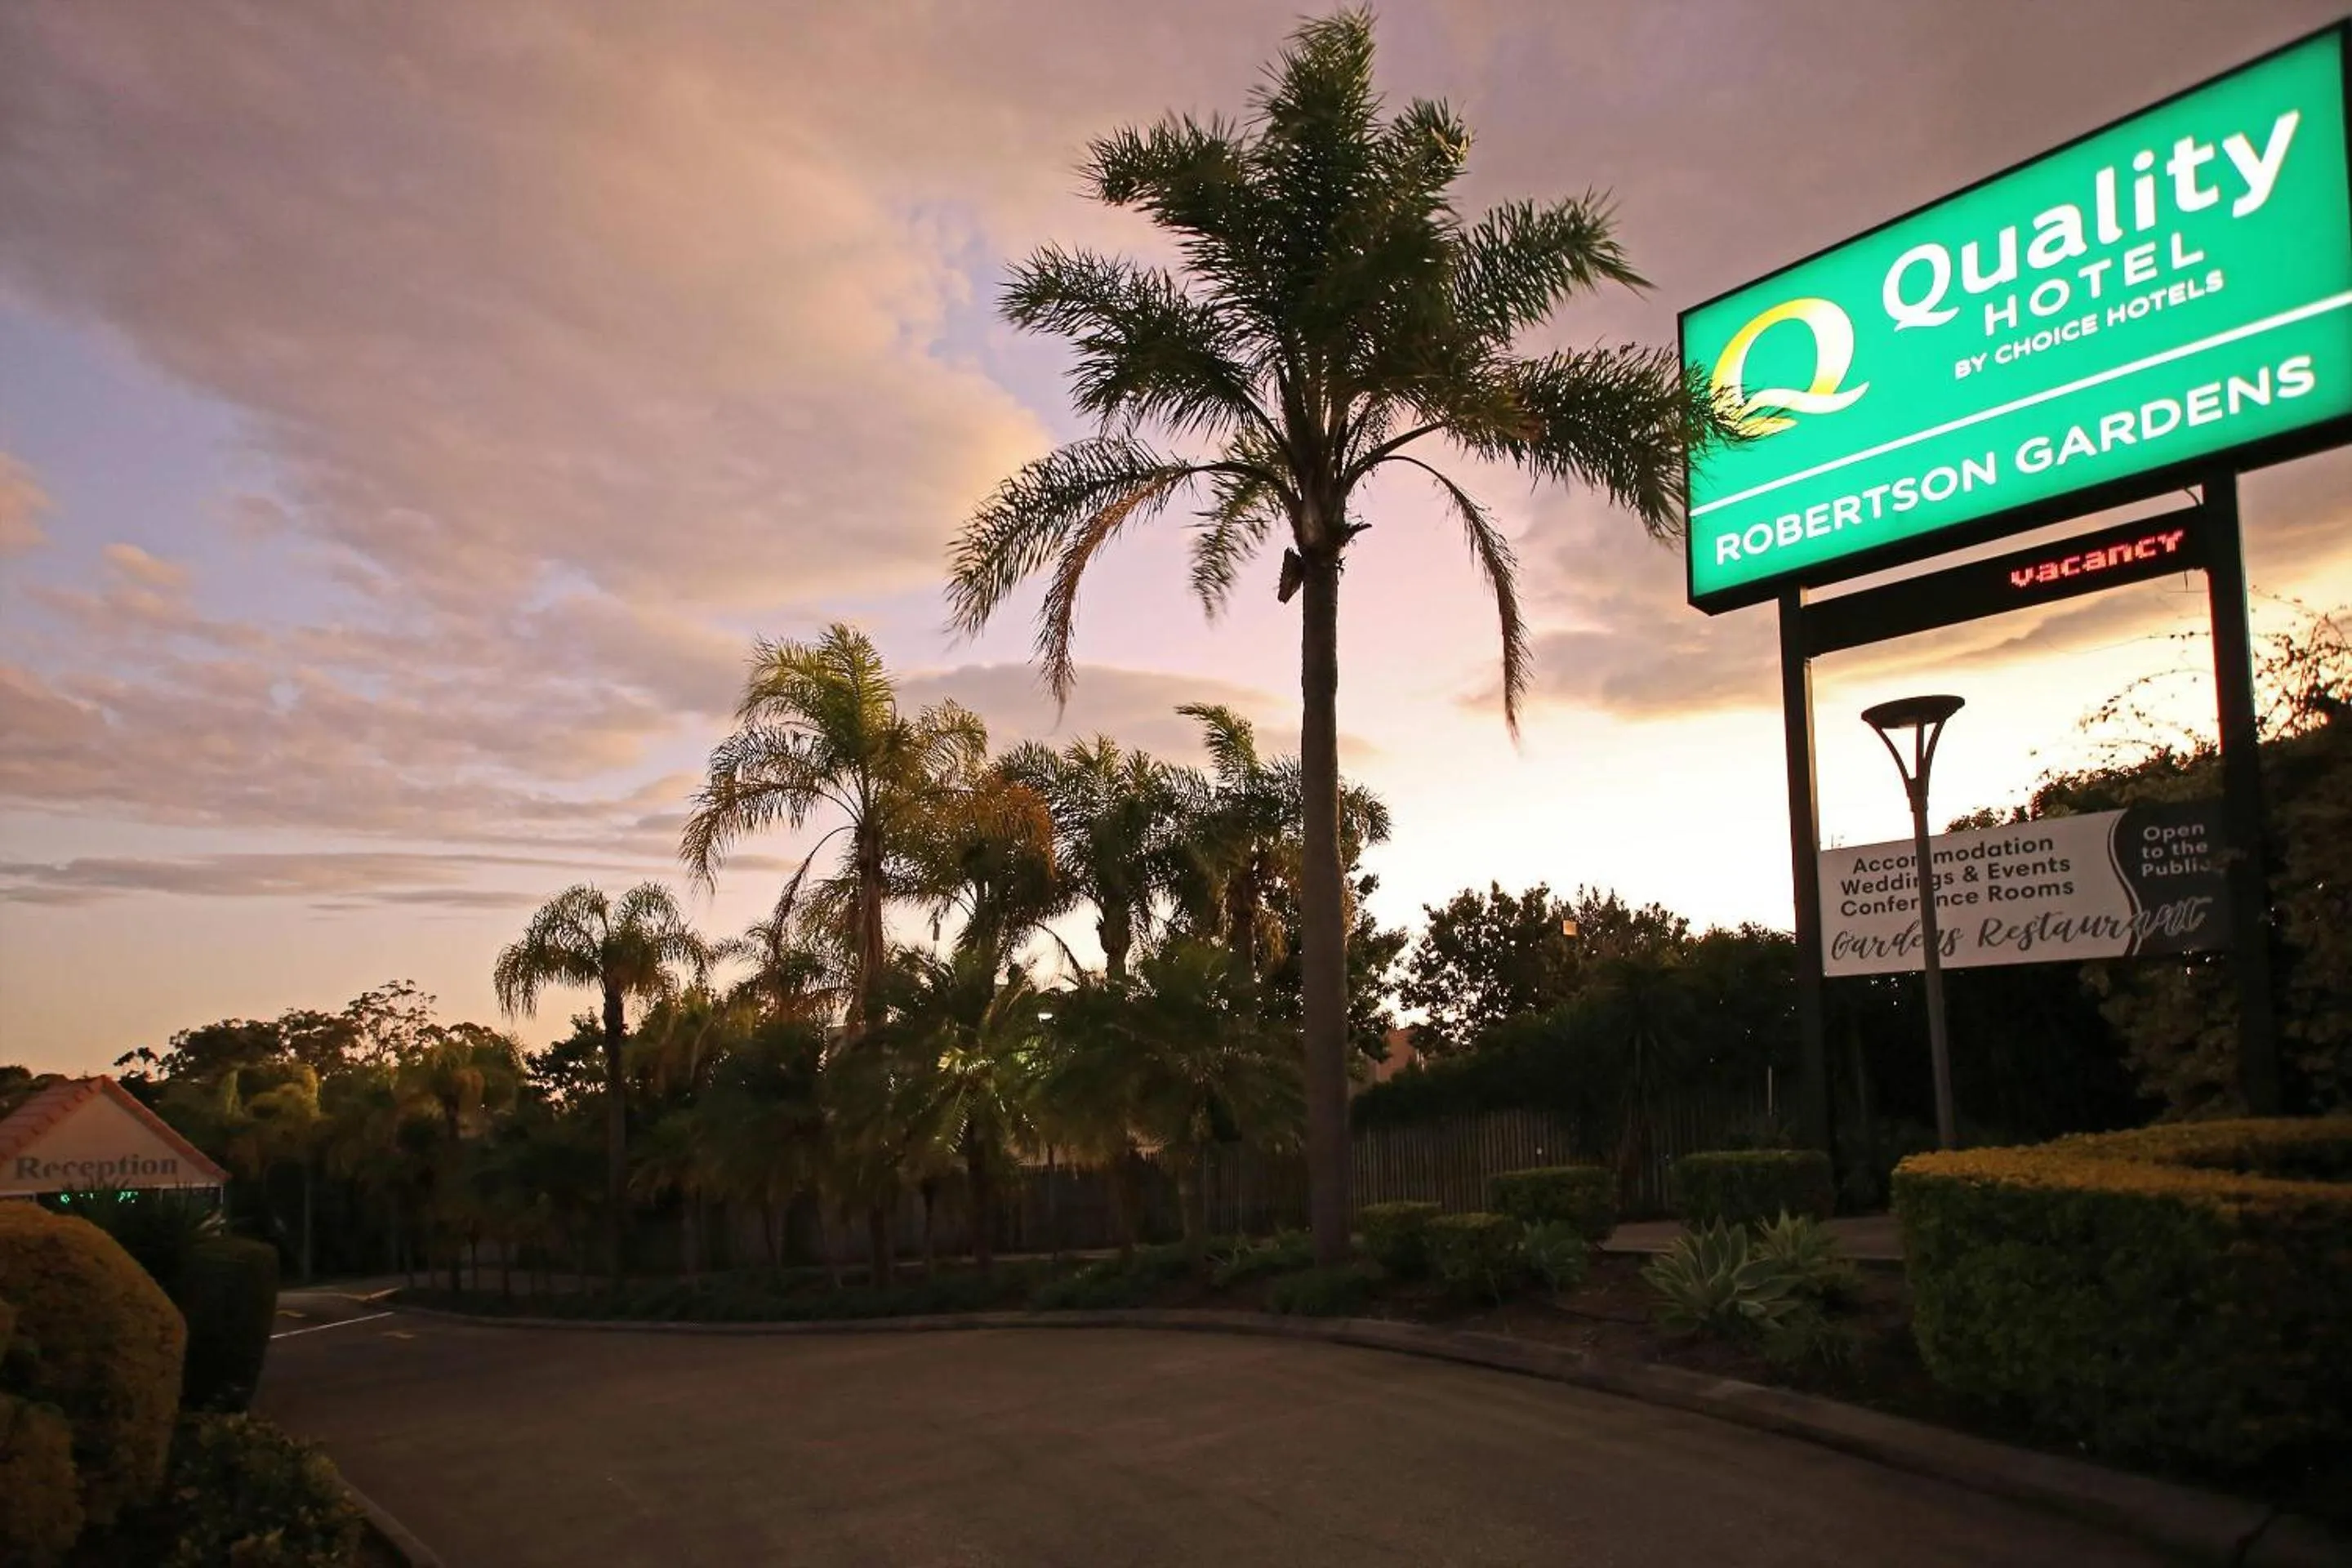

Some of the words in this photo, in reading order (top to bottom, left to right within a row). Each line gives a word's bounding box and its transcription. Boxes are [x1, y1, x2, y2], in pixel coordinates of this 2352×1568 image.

[1882, 111, 2300, 331] Quality
[1985, 233, 2204, 336] HOTEL
[1954, 352, 1988, 380] BY
[1994, 313, 2099, 364] CHOICE
[2106, 269, 2225, 327] HOTELS
[1716, 451, 1998, 565] ROBERTSON
[2015, 354, 2316, 474] GARDENS
[2141, 844, 2164, 860] to
[2172, 840, 2208, 857] the
[2143, 823, 2205, 844] Open
[1852, 837, 2053, 875] Accomodation
[1962, 865, 1980, 883] &
[1987, 857, 2071, 880] Events
[1840, 891, 1979, 917] Confernce
[1987, 880, 2074, 902] Rooms
[16, 1153, 178, 1181] Reception
